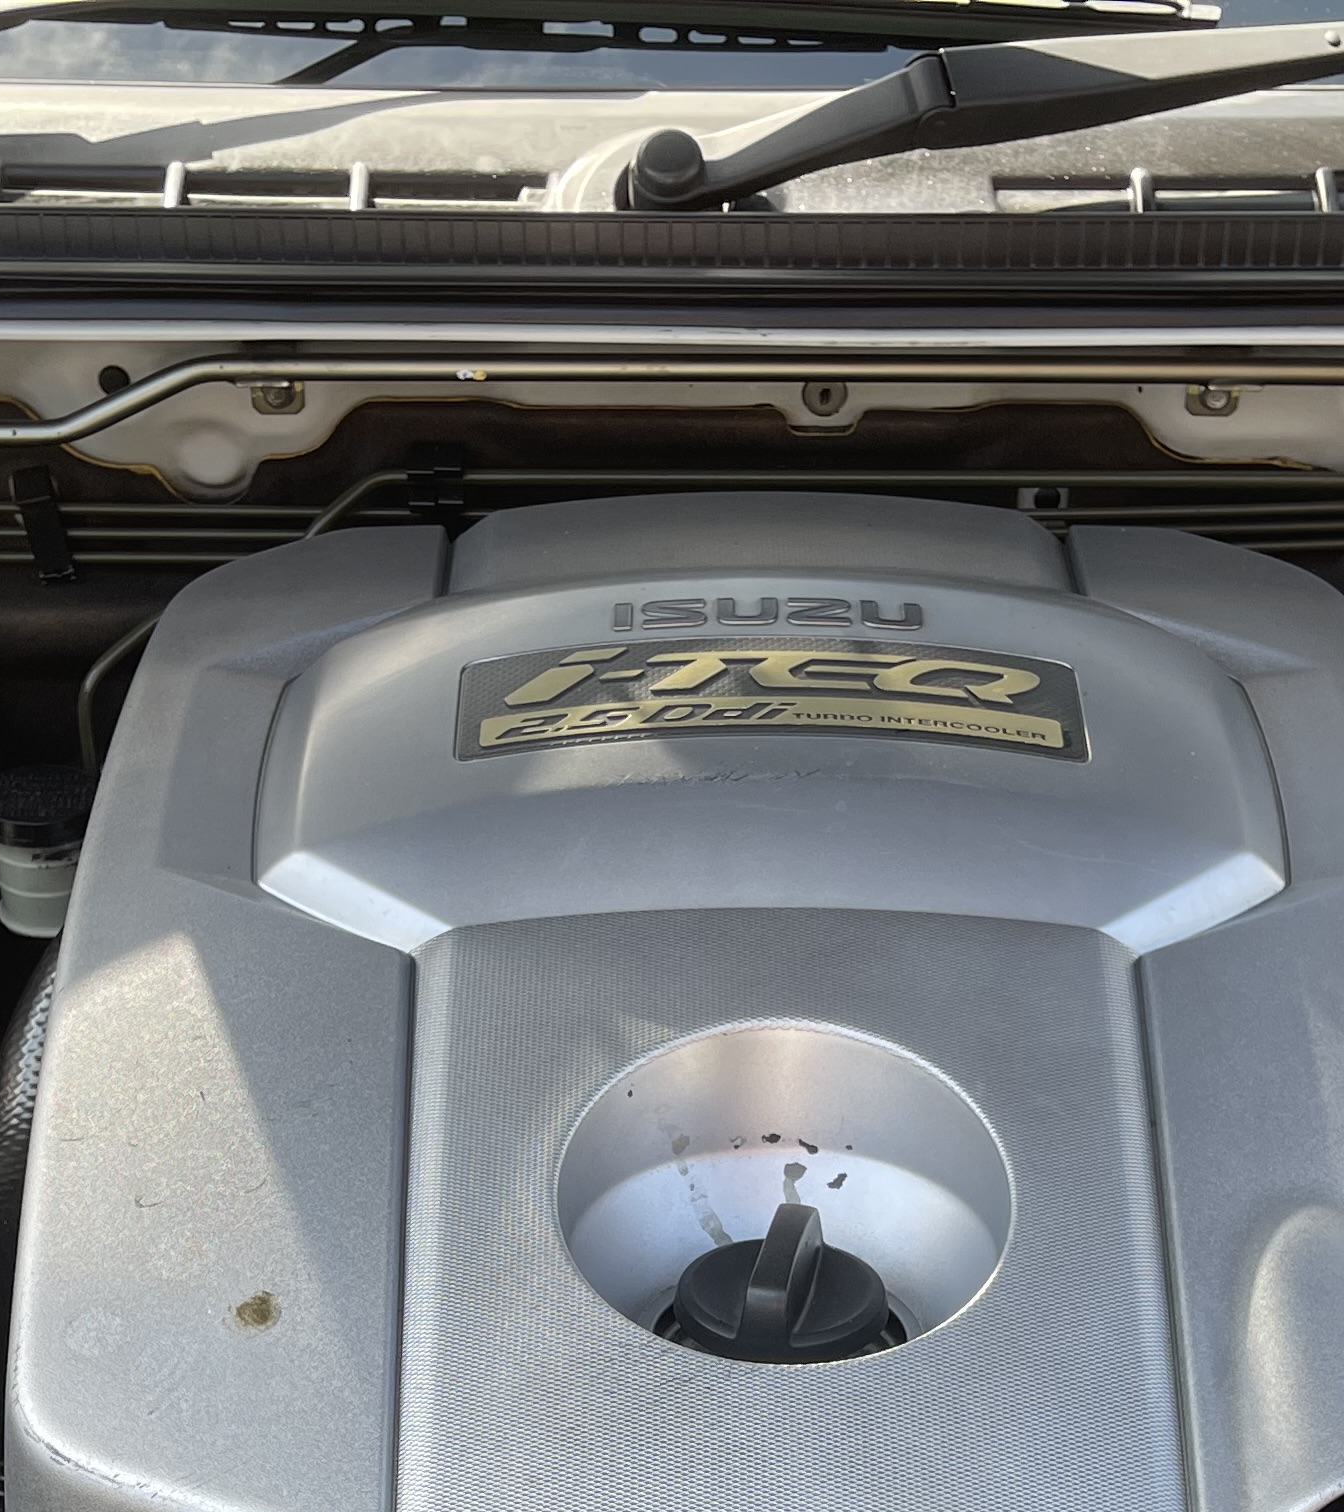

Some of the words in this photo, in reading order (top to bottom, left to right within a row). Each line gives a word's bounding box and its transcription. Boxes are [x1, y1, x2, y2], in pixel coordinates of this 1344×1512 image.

[614, 598, 923, 631] ISUZU
[792, 711, 873, 723] TURBO
[879, 715, 1047, 742] INTERCOOLER
